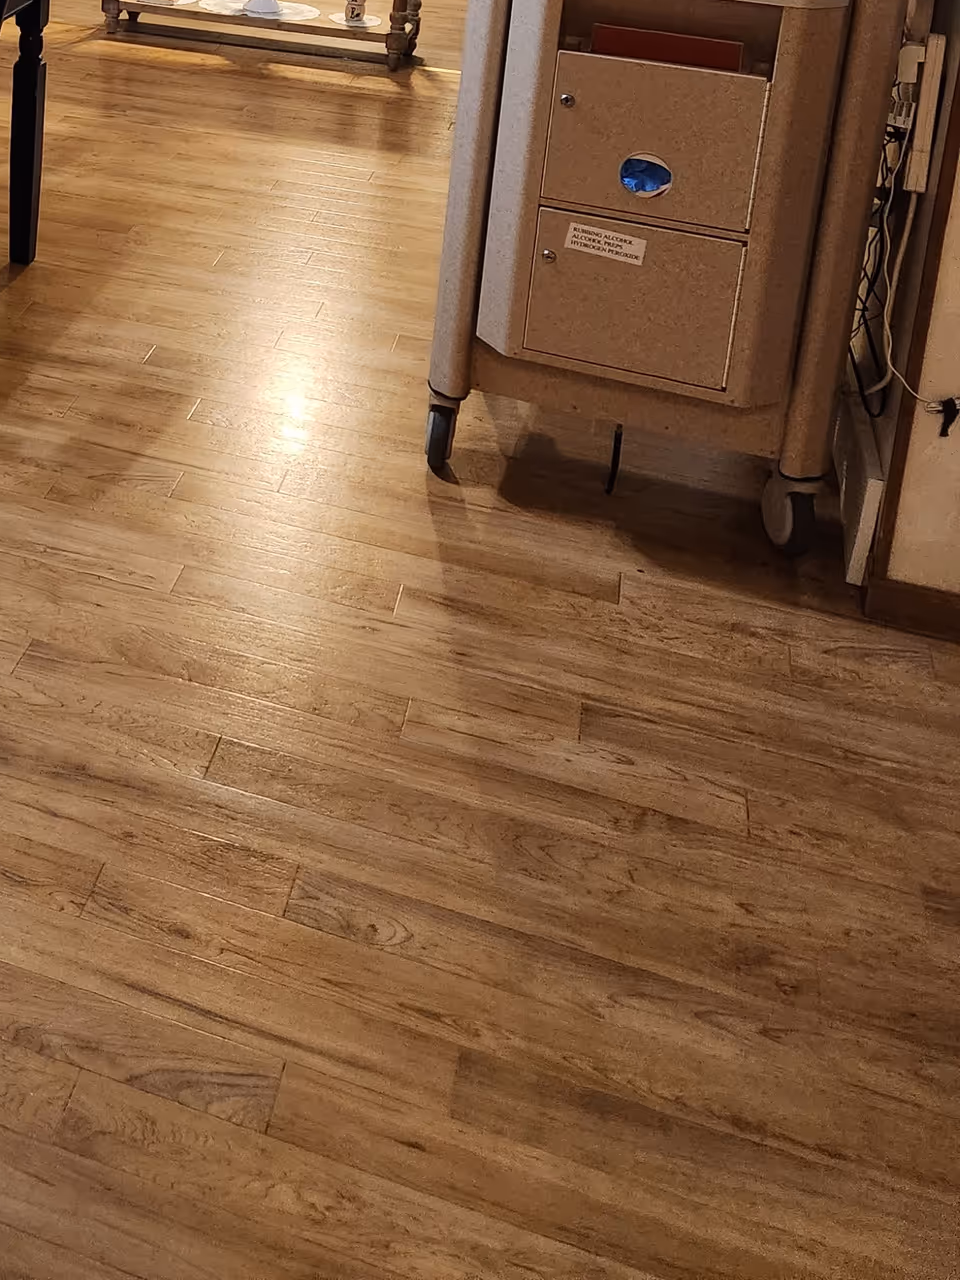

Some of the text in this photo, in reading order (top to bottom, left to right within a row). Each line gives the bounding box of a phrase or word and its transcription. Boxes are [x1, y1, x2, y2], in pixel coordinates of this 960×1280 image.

[572, 234, 623, 250] ALCOHOL PREPS
[573, 227, 633, 245] RUBBING ALCOHOL
[570, 240, 640, 260] HYDROGEN PEROXIDE
